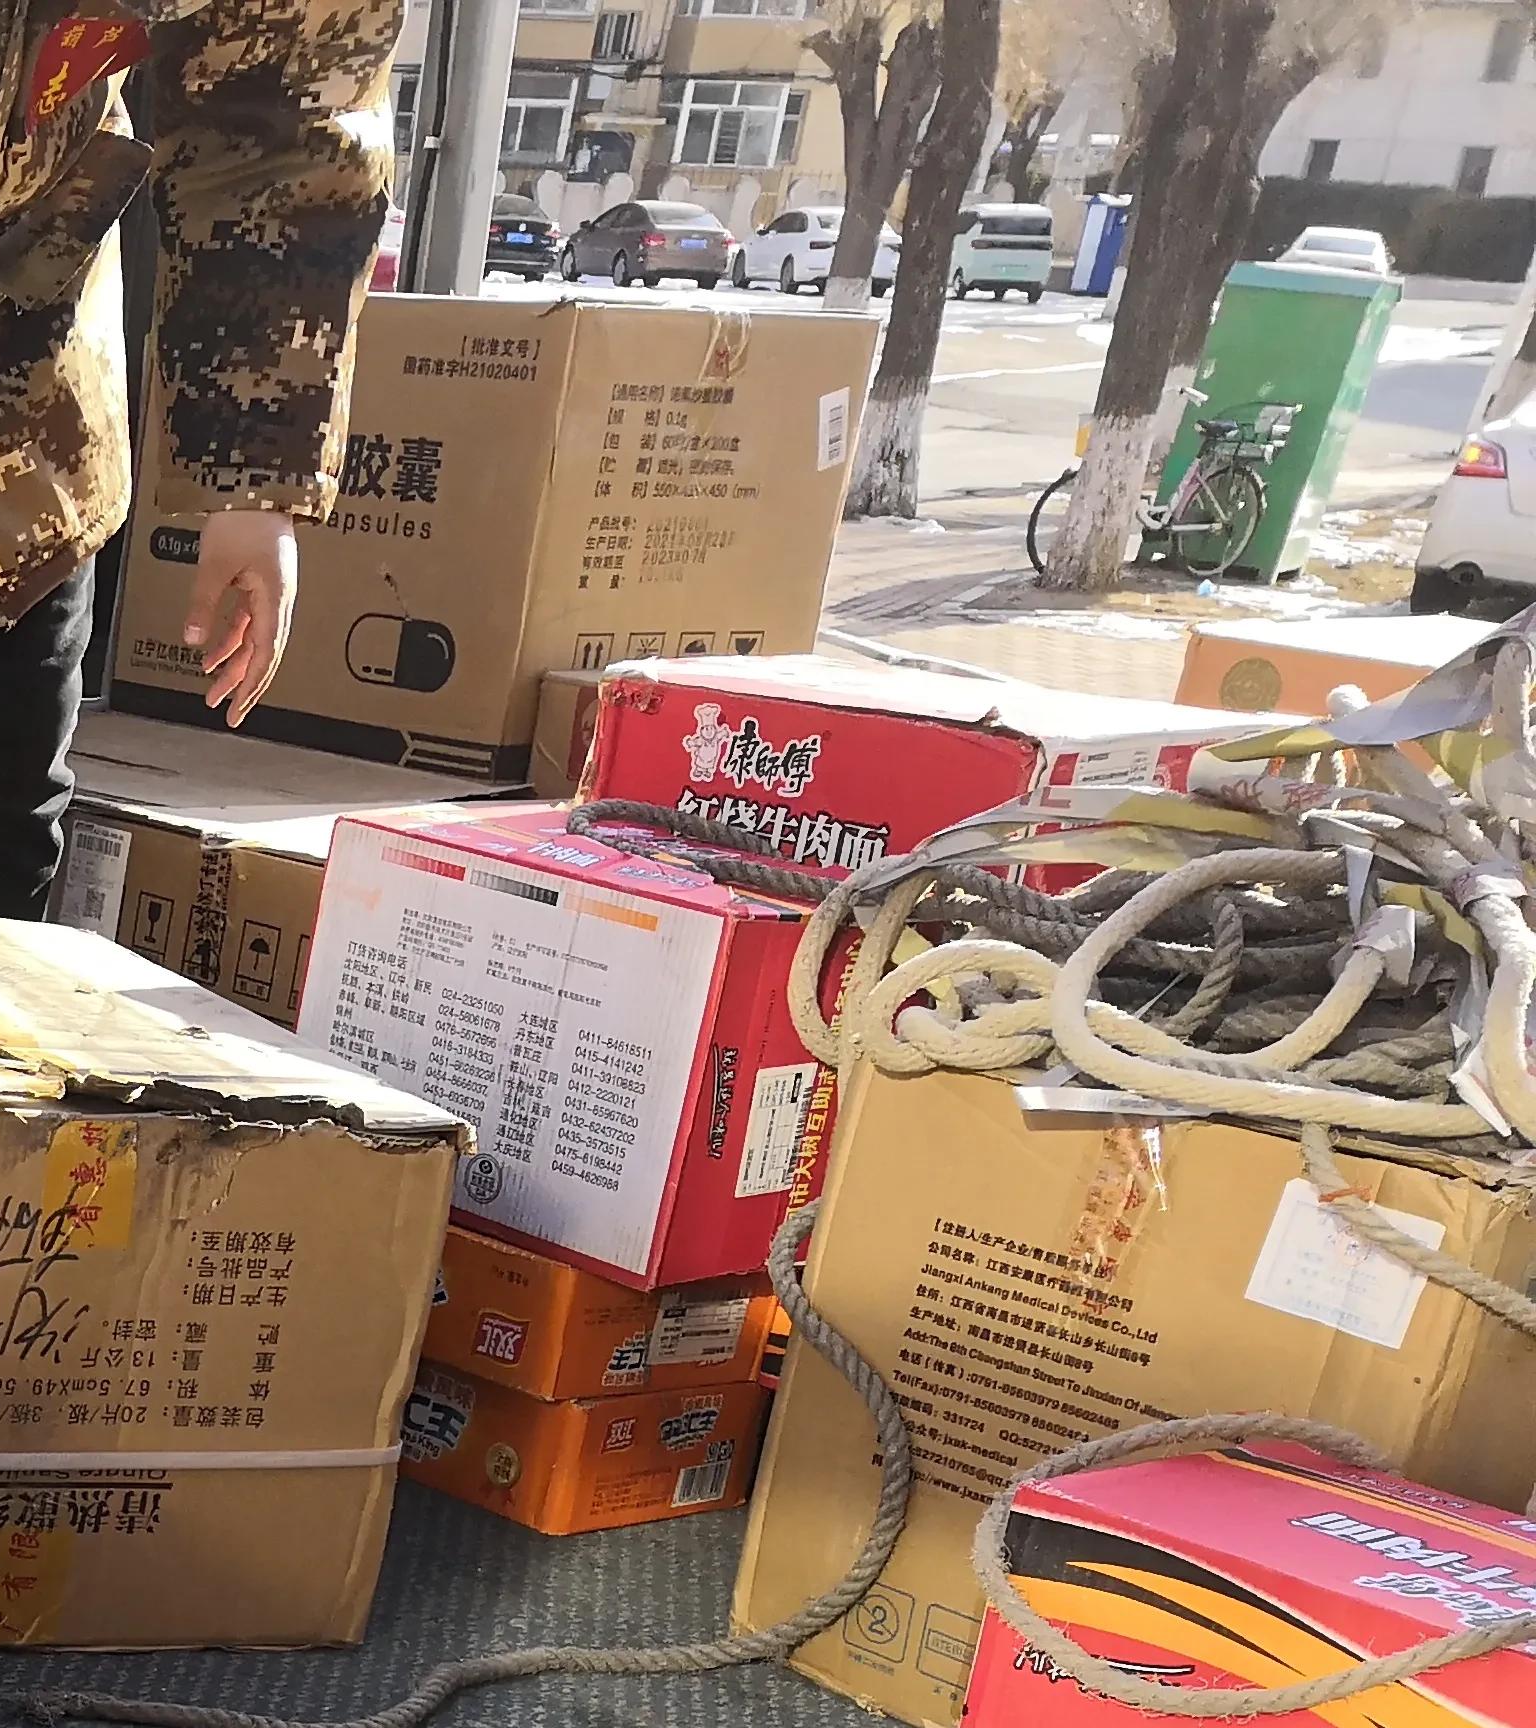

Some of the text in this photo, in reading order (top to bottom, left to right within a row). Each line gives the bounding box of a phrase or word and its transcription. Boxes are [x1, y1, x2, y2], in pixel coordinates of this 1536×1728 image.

[326, 509, 433, 541] apsules
[190, 1230, 295, 1253] 有效期至：
[186, 1257, 293, 1281] 产品批号：
[182, 1282, 287, 1307] 生产日期：
[254, 1350, 277, 1372] 重
[249, 1379, 270, 1401] 体
